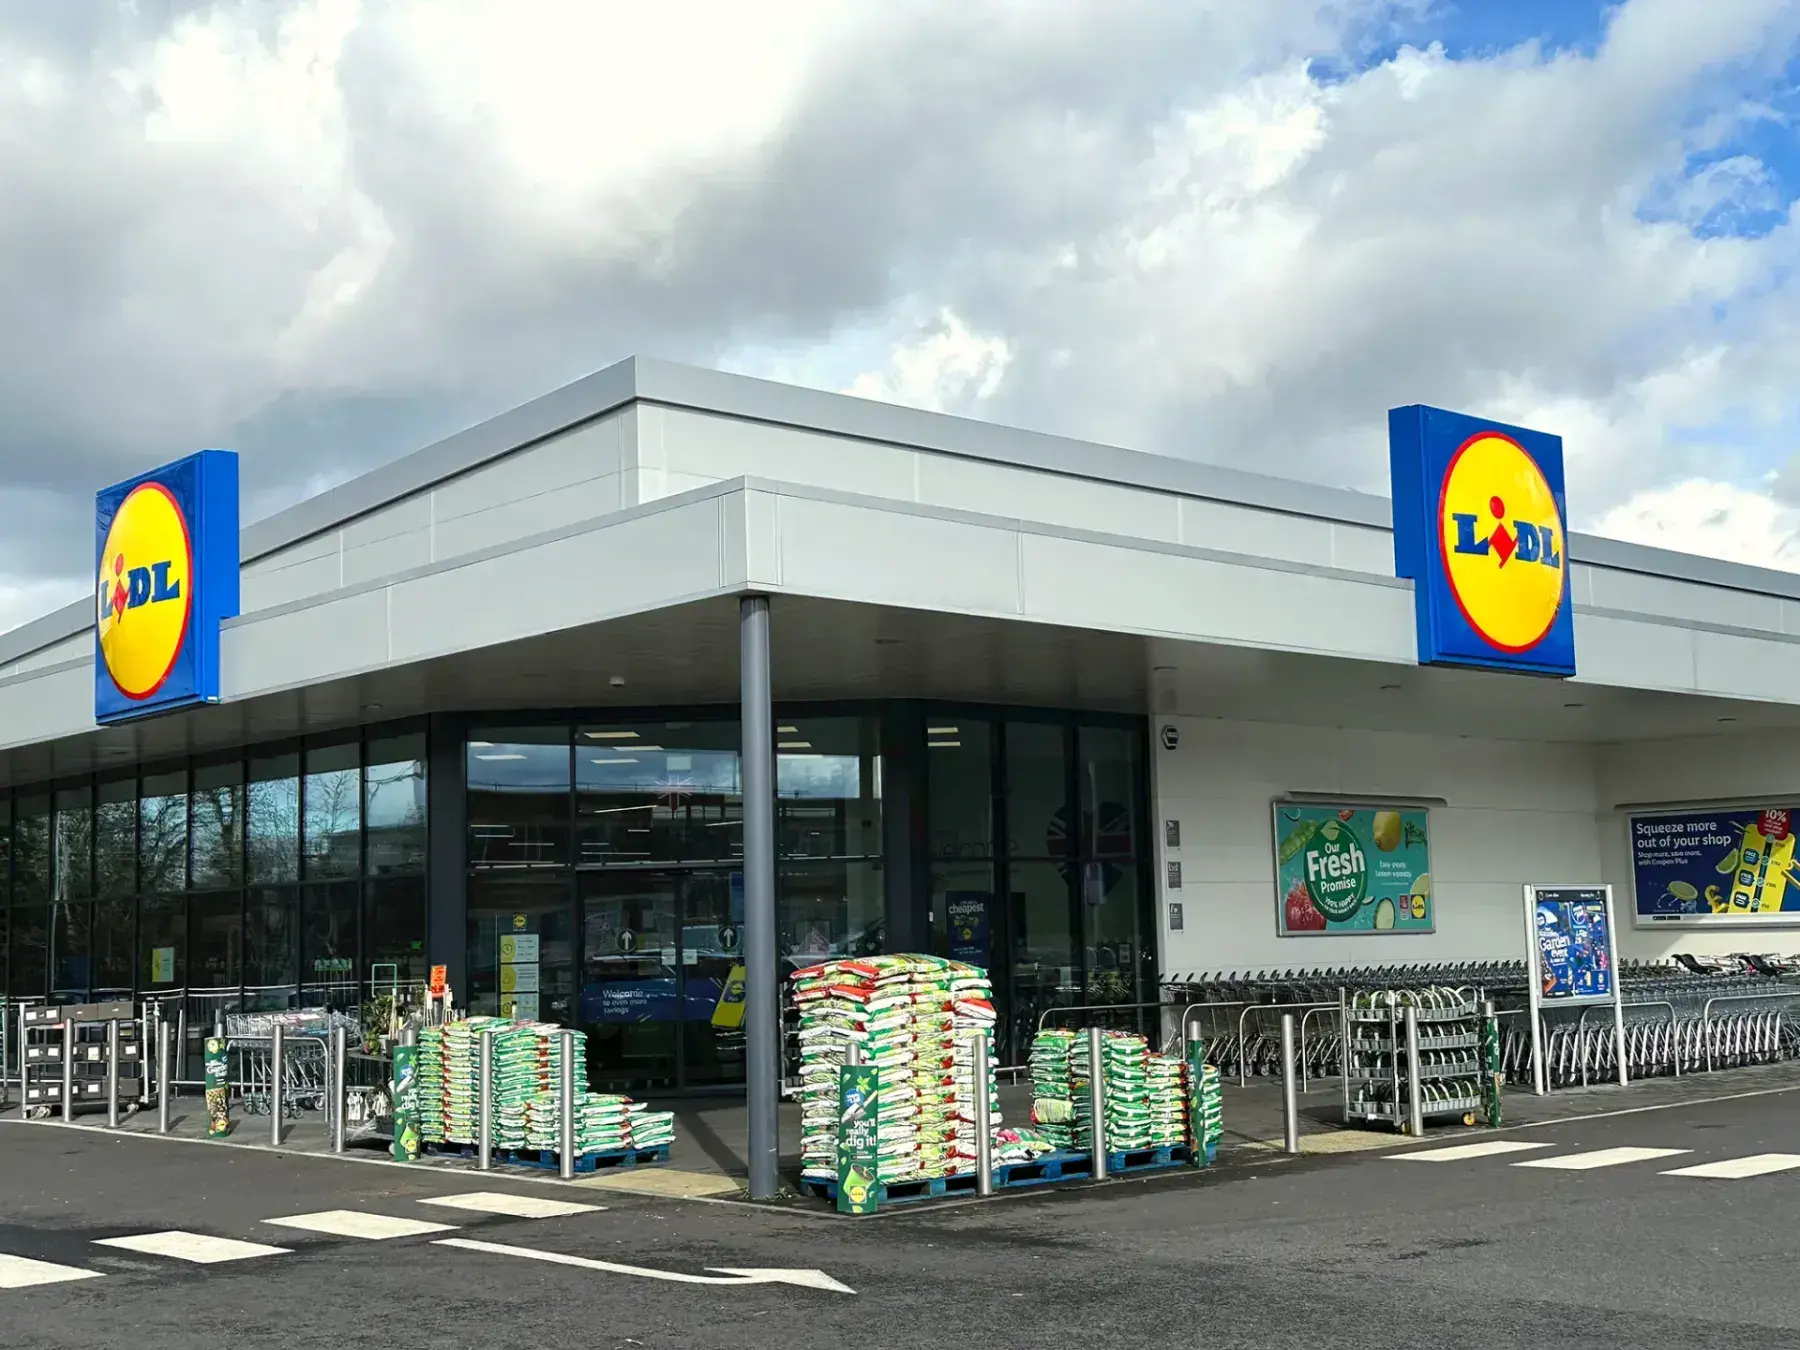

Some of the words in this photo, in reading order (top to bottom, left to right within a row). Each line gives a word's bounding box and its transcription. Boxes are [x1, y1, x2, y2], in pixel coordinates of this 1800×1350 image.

[1636, 823, 1684, 836] Squeeze
[1687, 821, 1717, 832] more
[1325, 842, 1340, 854] Our
[1637, 838, 1657, 848] out
[1660, 835, 1671, 847] of
[1673, 836, 1700, 849] your
[1702, 833, 1732, 847] shop
[1306, 842, 1366, 882] Fresh
[1320, 876, 1357, 894] Promise
[948, 903, 985, 916] cheapest
[602, 989, 644, 999] Welcome
[845, 1126, 870, 1137] really
[845, 1134, 865, 1150] dig
